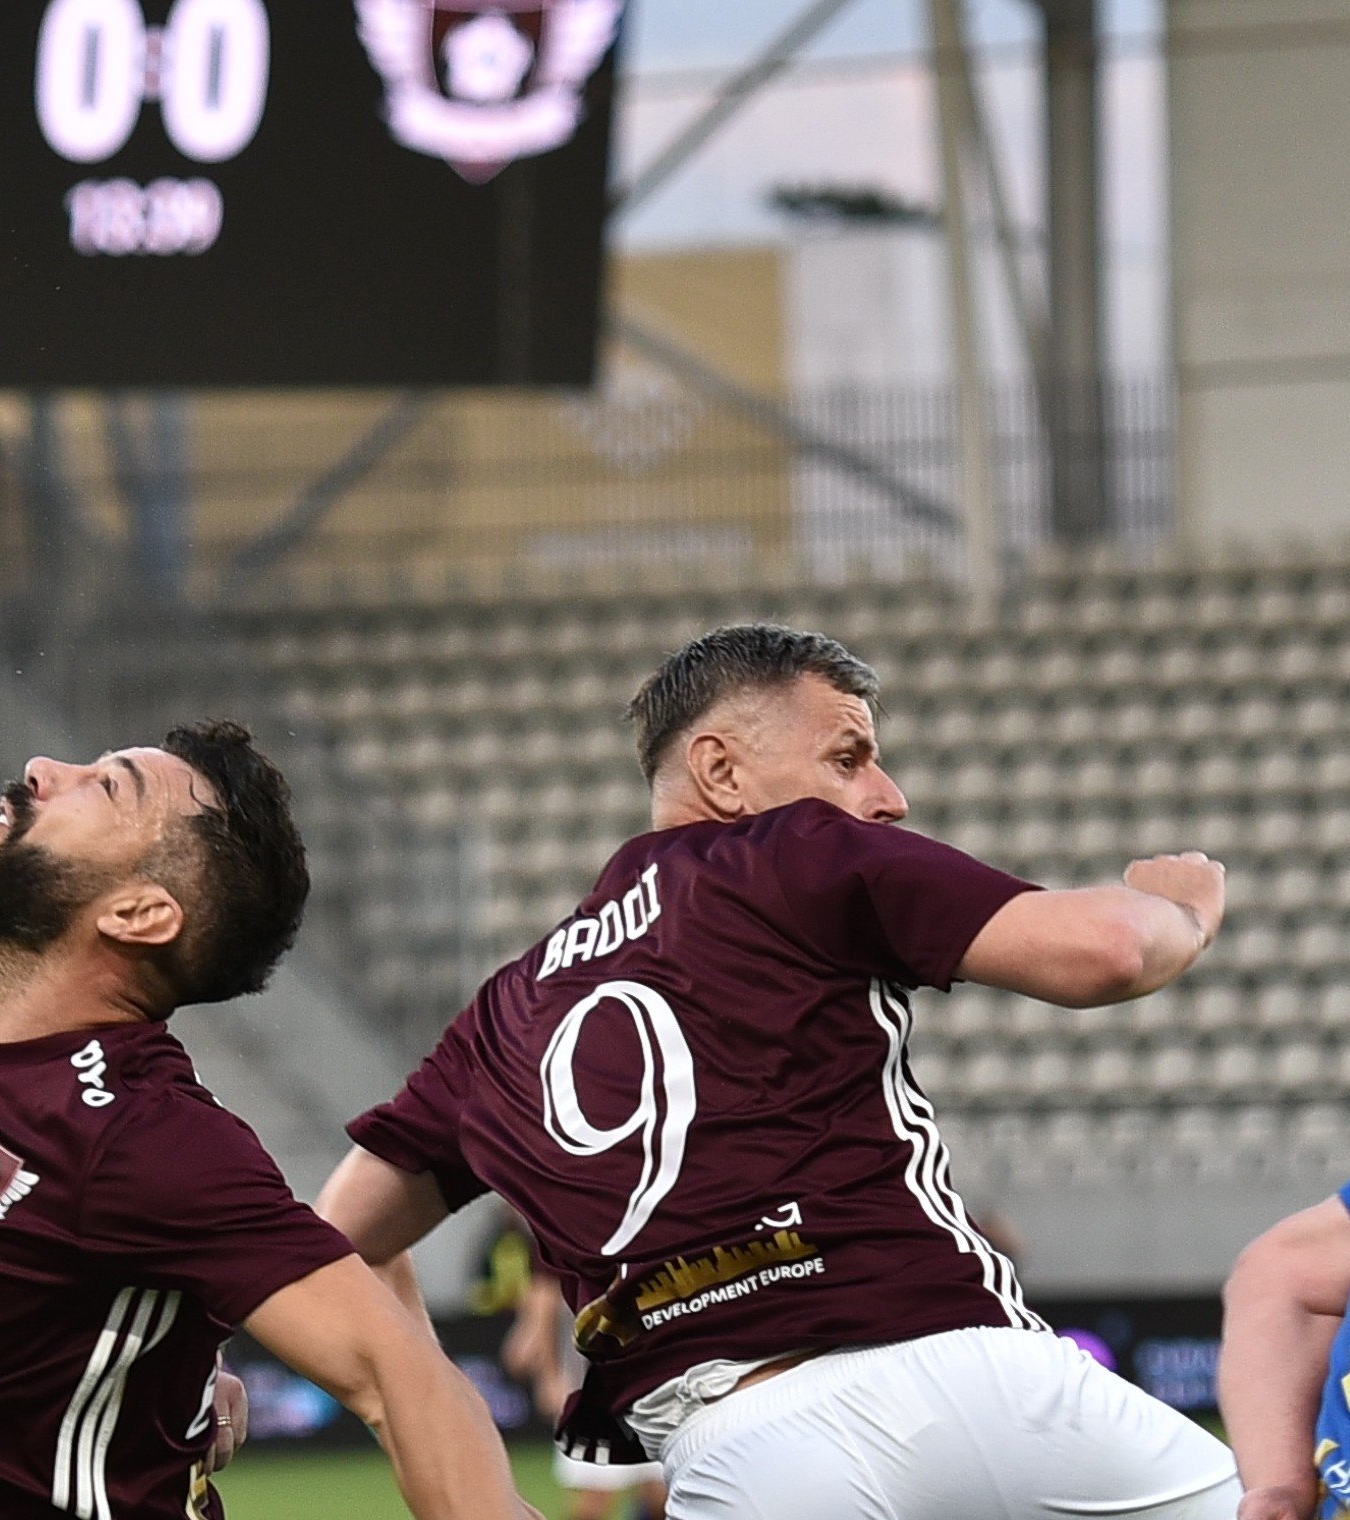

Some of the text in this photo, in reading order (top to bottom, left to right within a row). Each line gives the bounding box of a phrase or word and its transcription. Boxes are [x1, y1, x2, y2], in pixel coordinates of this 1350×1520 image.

[540, 980, 696, 1255] 9
[641, 1257, 826, 1331] DEVELOPMENT EUROPE
